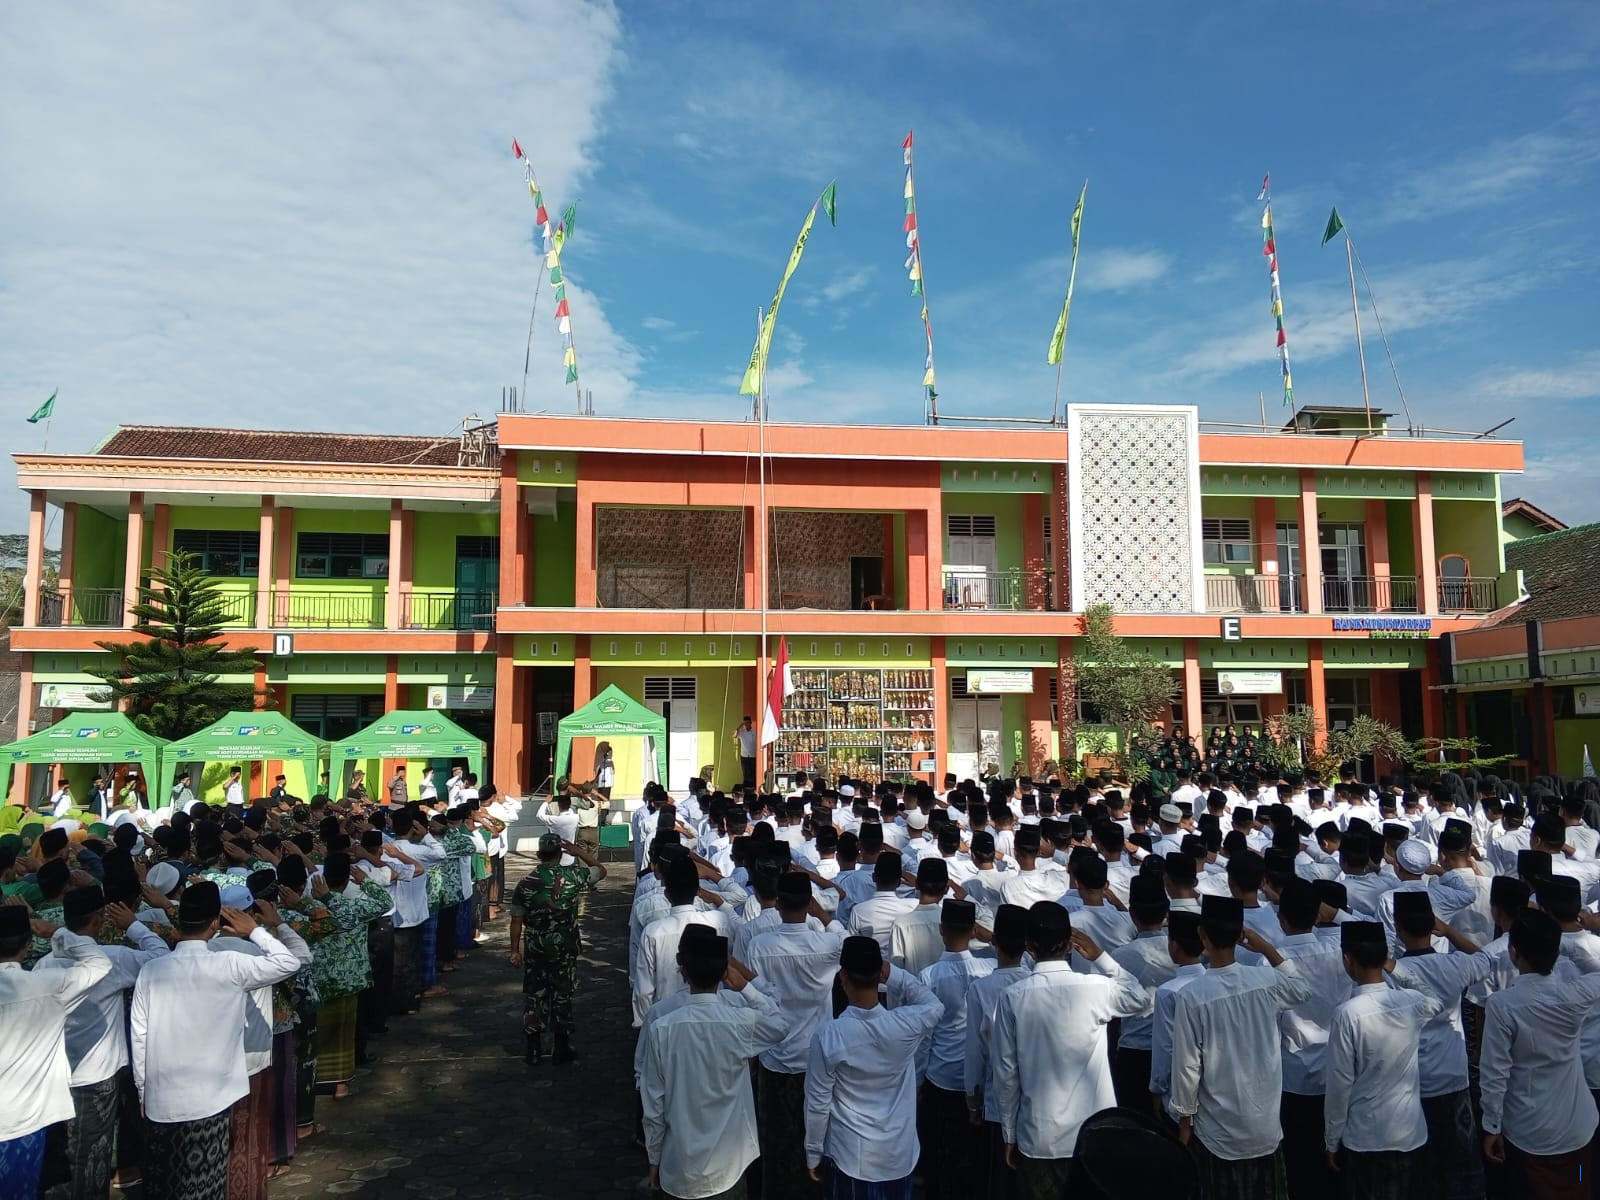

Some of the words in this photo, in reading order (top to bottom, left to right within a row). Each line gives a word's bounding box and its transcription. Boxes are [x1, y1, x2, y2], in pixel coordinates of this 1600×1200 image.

[1224, 618, 1240, 640] E
[1334, 618, 1363, 630] BANK
[276, 635, 290, 655] D
